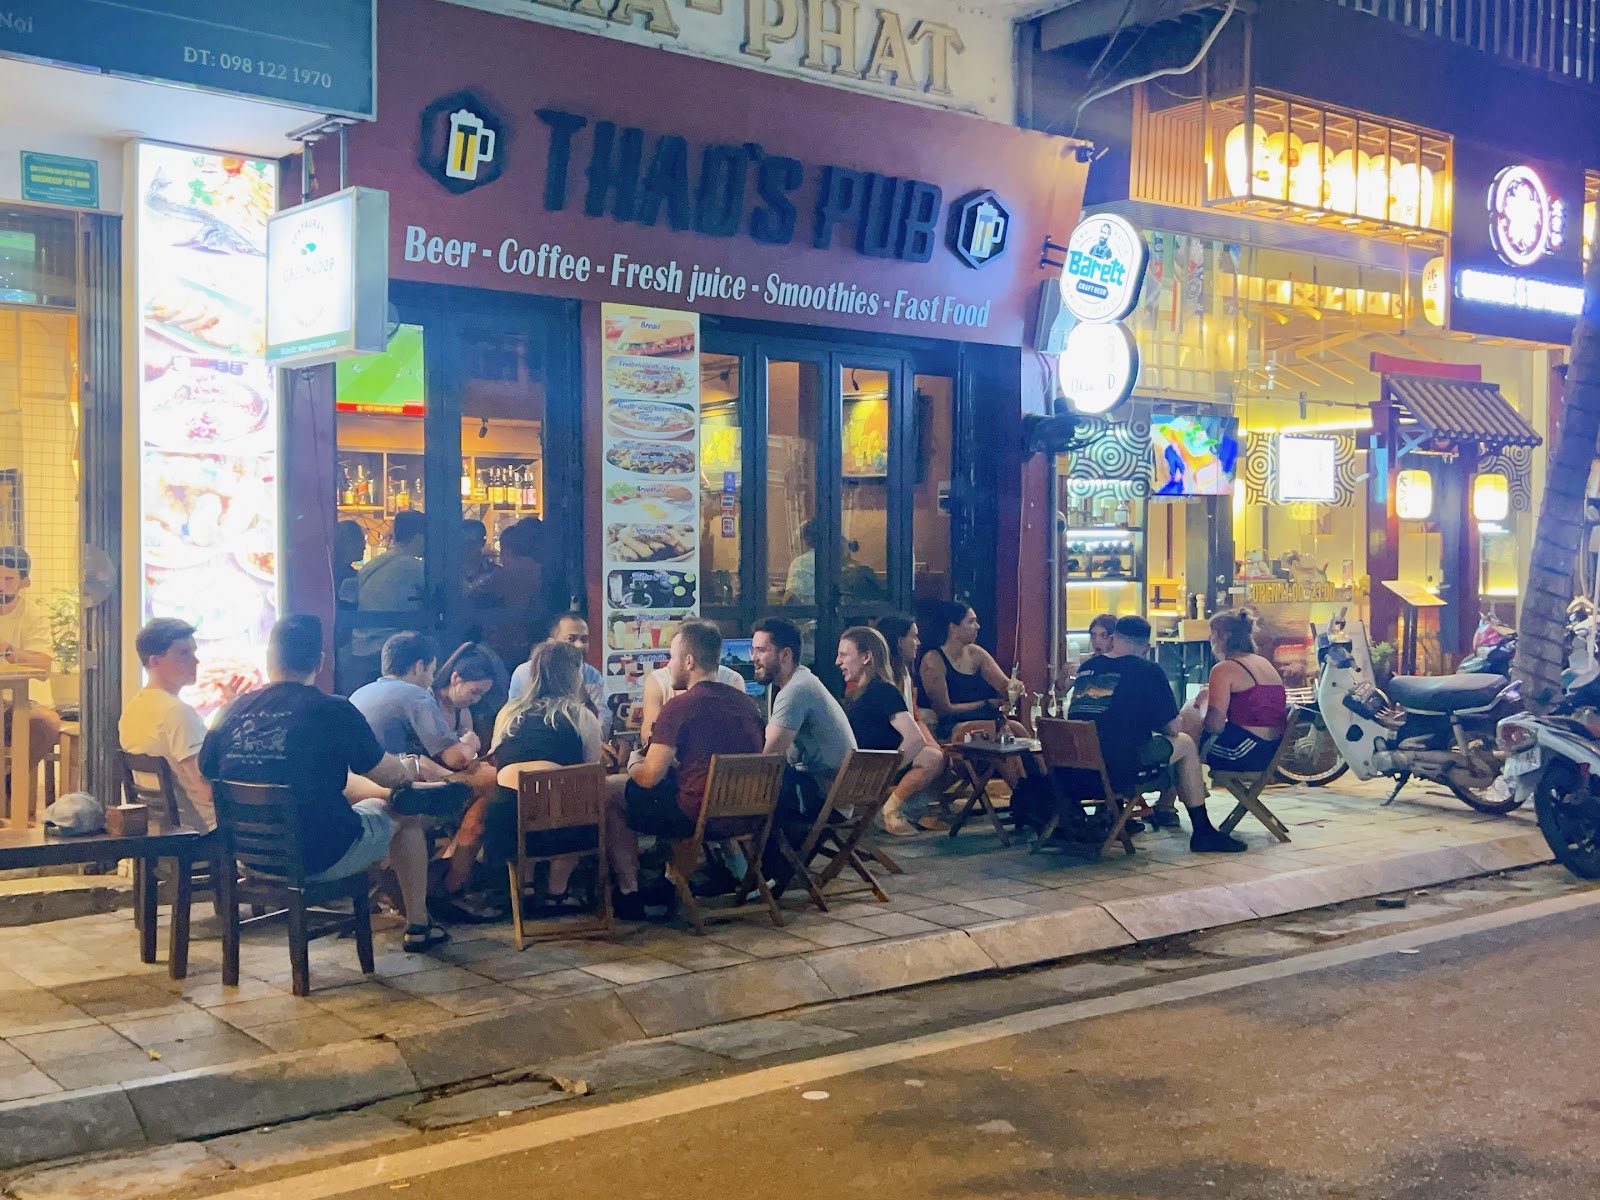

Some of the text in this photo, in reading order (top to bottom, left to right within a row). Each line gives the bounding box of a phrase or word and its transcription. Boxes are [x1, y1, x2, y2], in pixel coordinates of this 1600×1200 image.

[220, 53, 252, 74] 098
[257, 61, 288, 81] 122
[292, 67, 332, 89] 1970
[813, 164, 943, 264] PUB
[404, 225, 477, 268] Beer
[498, 238, 592, 282] Coffee
[611, 253, 684, 294] Fresh
[686, 264, 746, 303] juice
[763, 272, 880, 316] Smoothies
[893, 290, 940, 322] Fast
[942, 296, 992, 328] Food
[1068, 250, 1126, 286] Barett
[1078, 282, 1095, 293] CRAFT
